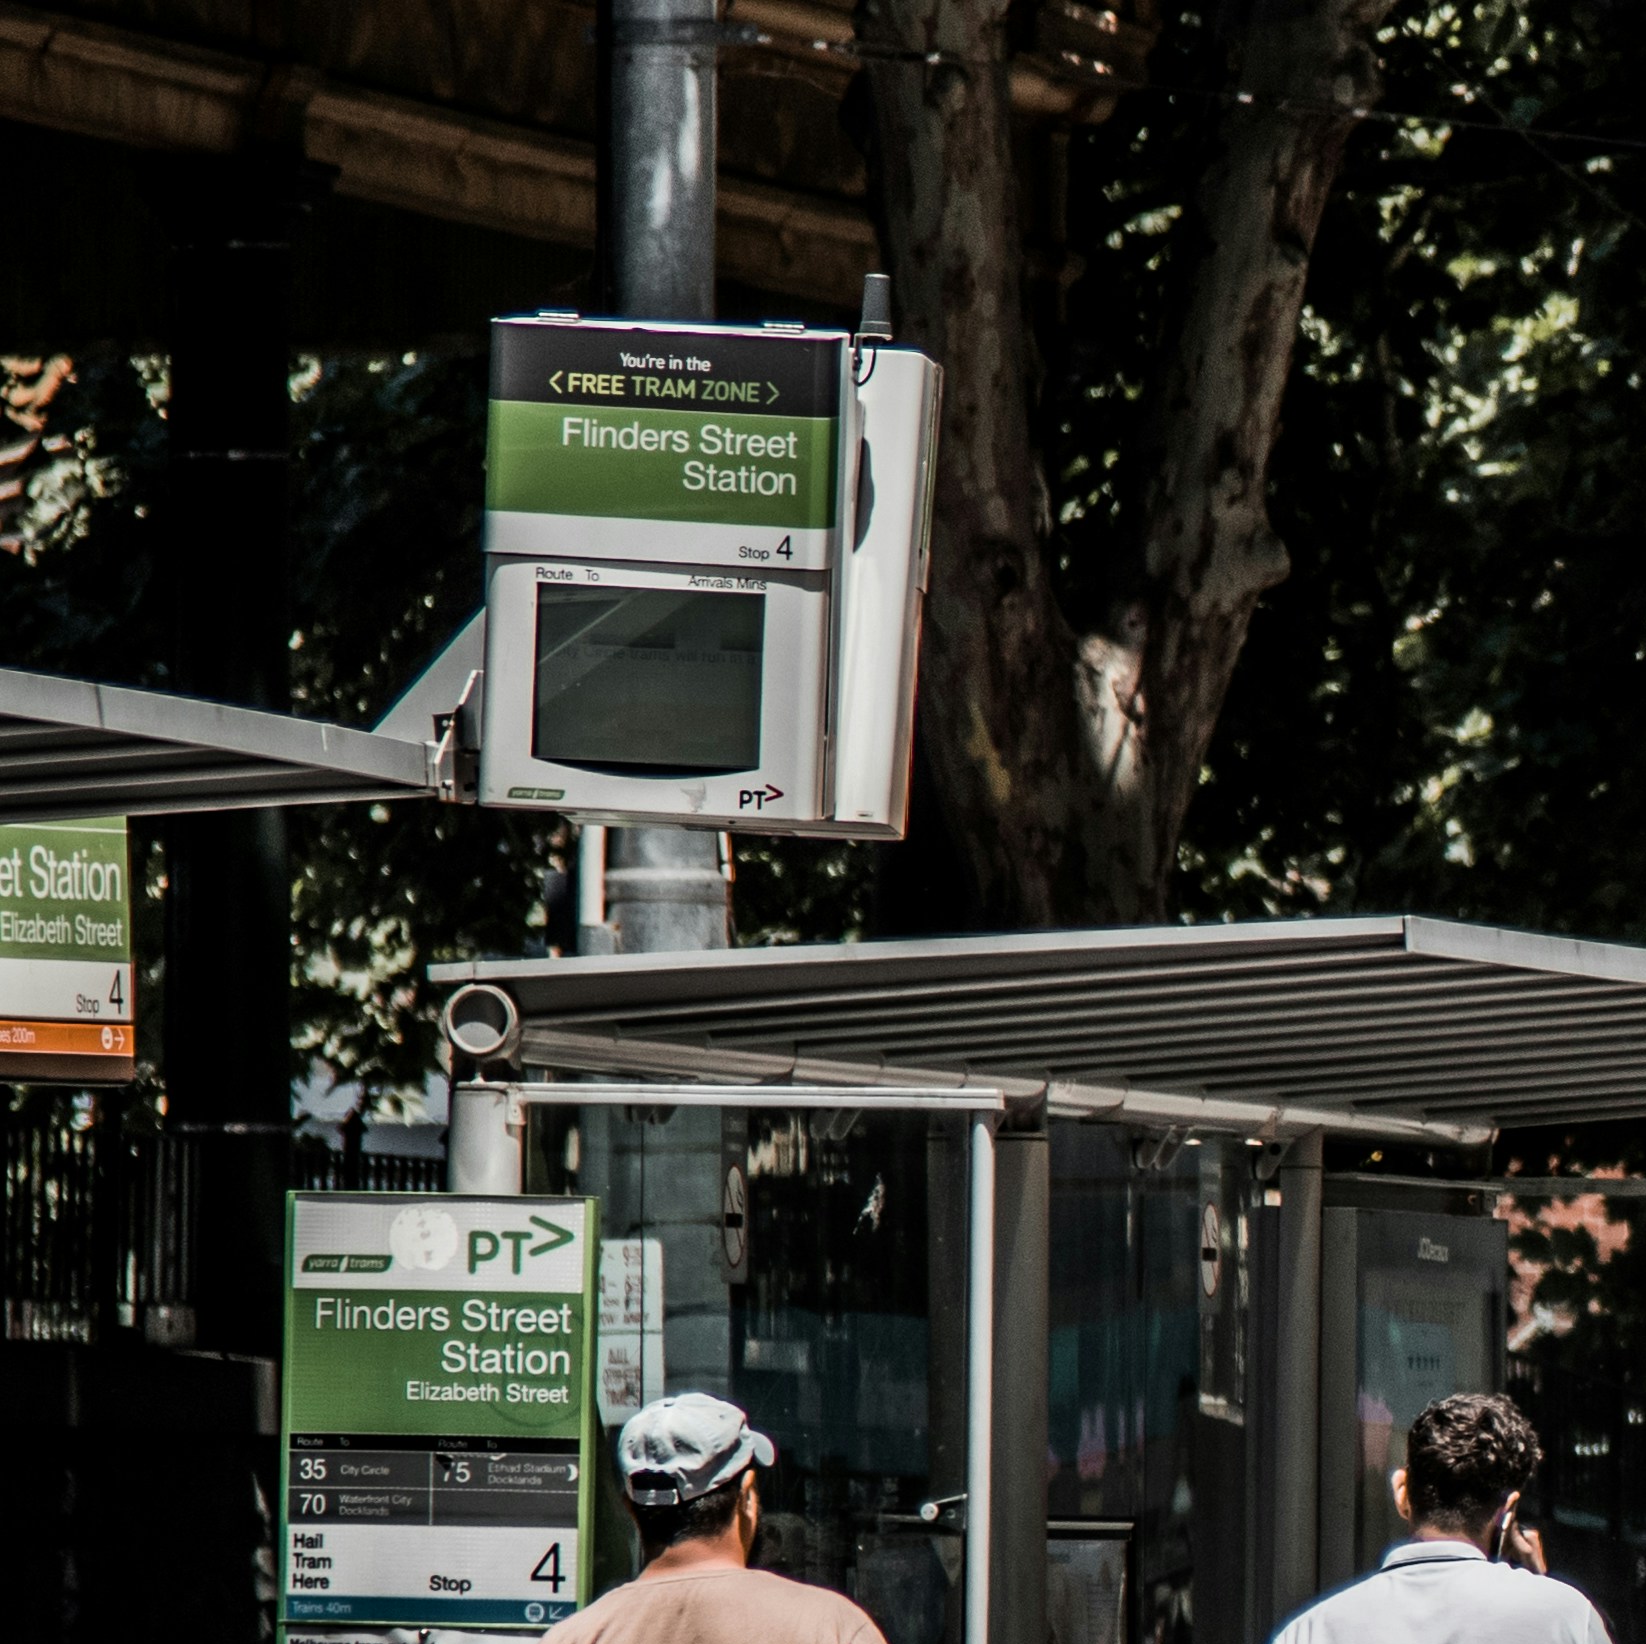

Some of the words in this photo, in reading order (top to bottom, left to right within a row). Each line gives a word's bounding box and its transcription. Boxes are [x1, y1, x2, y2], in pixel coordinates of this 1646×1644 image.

[620, 352, 666, 370] You're
[668, 354, 683, 370] in
[686, 356, 712, 372] the
[567, 373, 626, 397] FREE
[631, 375, 696, 399] TRAM
[701, 380, 761, 403] ZONE
[562, 416, 690, 453] Flinders
[699, 424, 798, 459] Street
[682, 460, 797, 496] Station
[738, 546, 770, 561] Stop
[776, 535, 794, 561] 4
[536, 567, 573, 581] Route
[585, 569, 600, 582] To
[688, 575, 733, 589] Arrivals
[736, 577, 768, 592] Mins
[29, 845, 122, 901] Station
[1, 910, 71, 945] Elizabeth
[75, 914, 123, 947] Street
[76, 994, 99, 1017] Stop
[108, 969, 124, 1015] 4
[315, 1298, 450, 1331] Flinders
[462, 1299, 573, 1335] Street
[440, 1340, 571, 1376] Station
[406, 1380, 500, 1402] Elizabeth
[505, 1381, 569, 1404] Street
[300, 1458, 327, 1480] 35
[300, 1493, 327, 1515] 70
[292, 1533, 323, 1549] Hail
[292, 1553, 332, 1569] Tram
[428, 1574, 471, 1595] Stop
[530, 1541, 566, 1593] 4
[292, 1573, 330, 1589] Here
[293, 1601, 325, 1614] Trains
[327, 1602, 352, 1614] 40m
